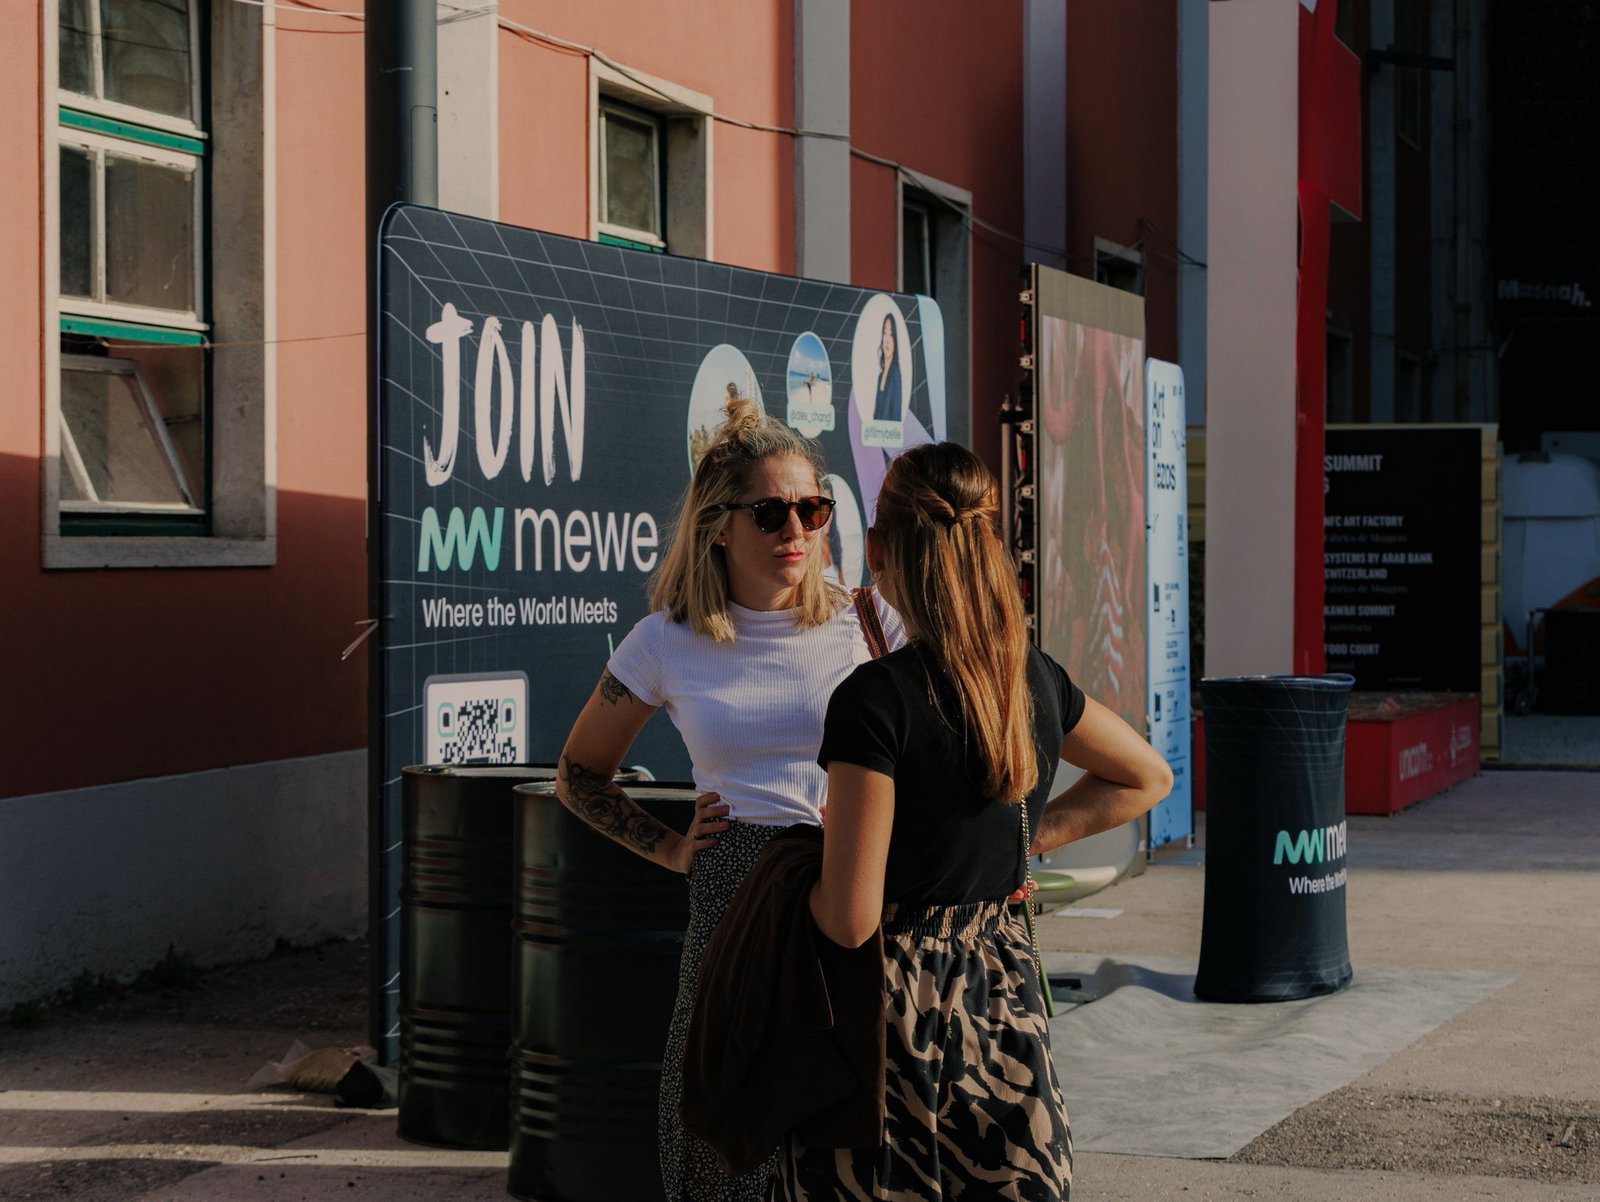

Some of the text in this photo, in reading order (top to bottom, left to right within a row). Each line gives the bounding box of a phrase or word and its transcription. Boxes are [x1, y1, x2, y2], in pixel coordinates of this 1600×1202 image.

[423, 302, 586, 487] JOIN
[1324, 454, 1383, 472] SUMMIT
[514, 507, 659, 573] mewe
[422, 596, 618, 628] Where the World Meets
[1289, 876, 1325, 894] Where
